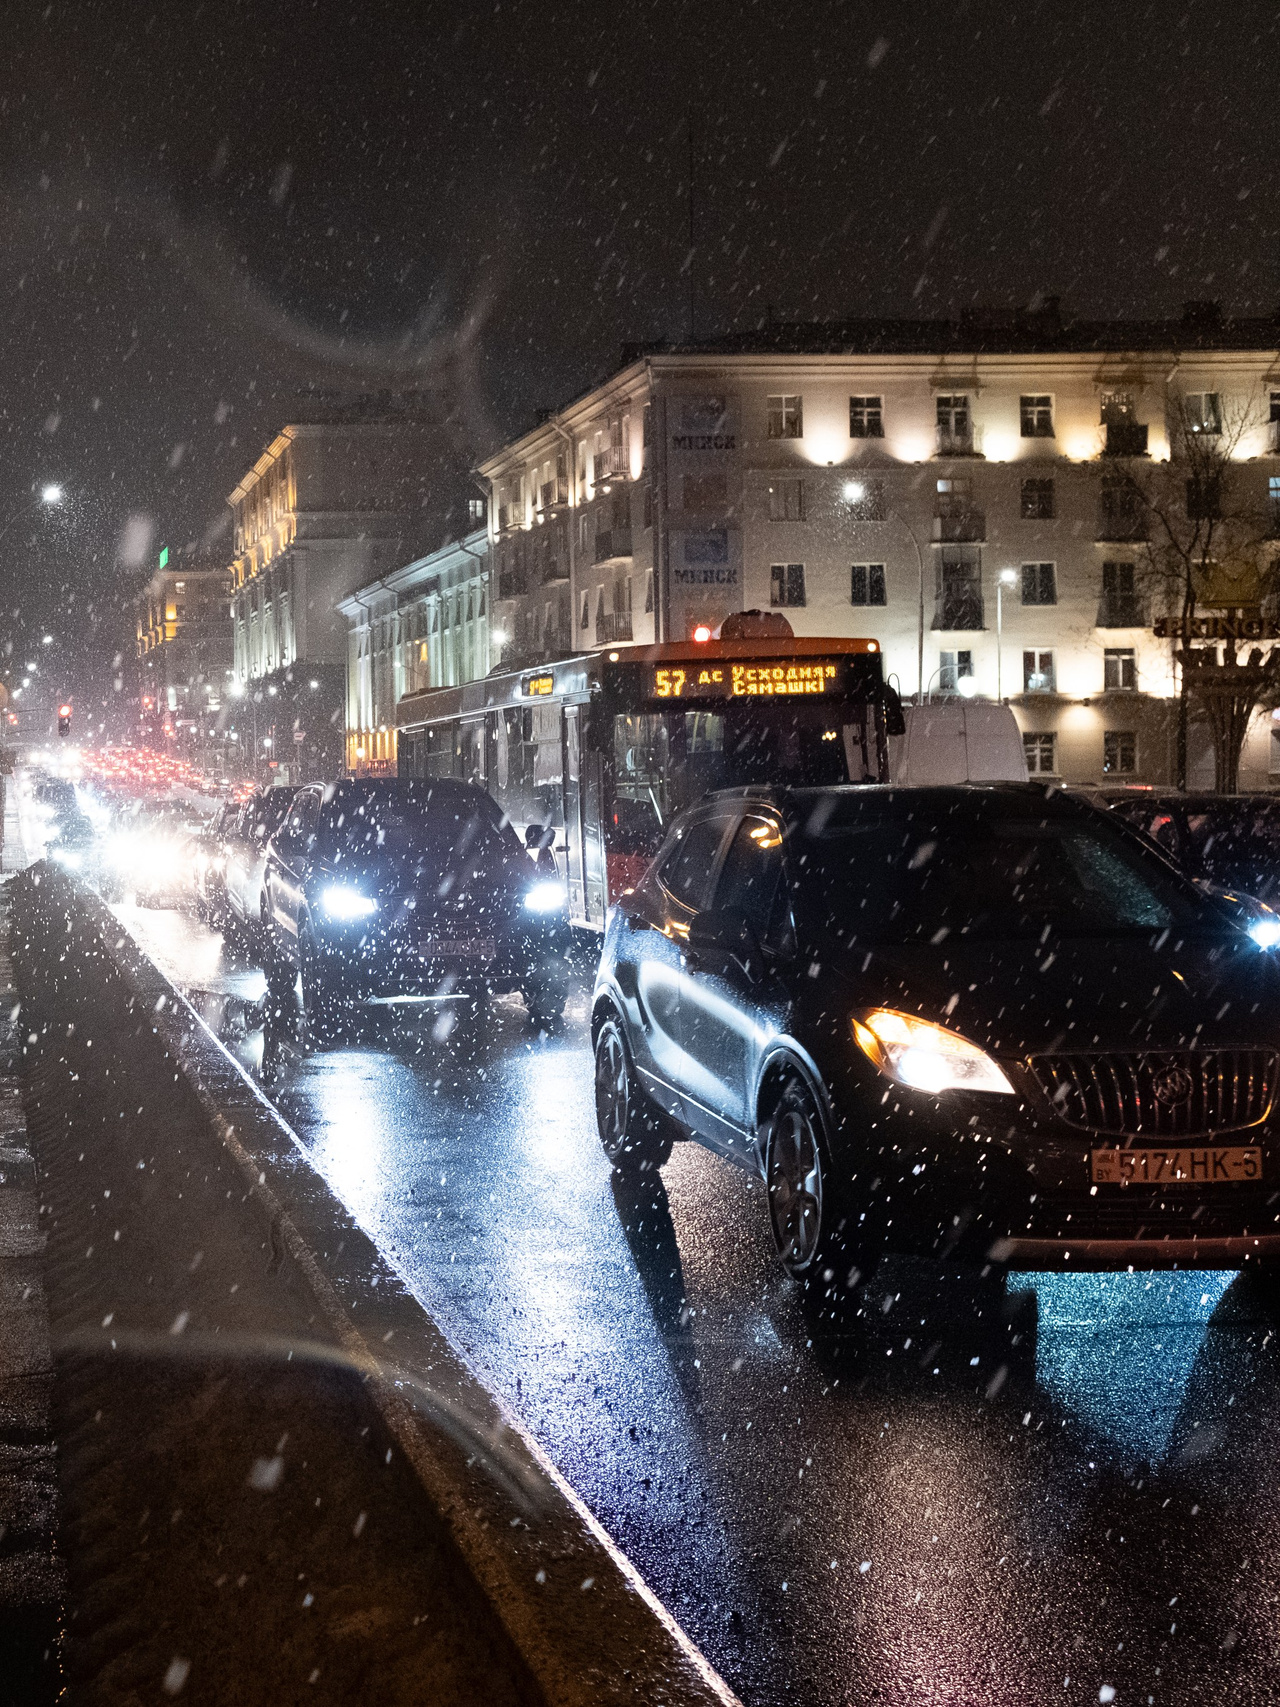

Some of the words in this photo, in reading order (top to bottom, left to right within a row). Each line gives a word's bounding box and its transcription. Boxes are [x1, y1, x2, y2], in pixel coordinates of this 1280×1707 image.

[656, 669, 686, 697] 57
[732, 679, 825, 695] Сямашкі
[1097, 1169, 1112, 1180] BY
